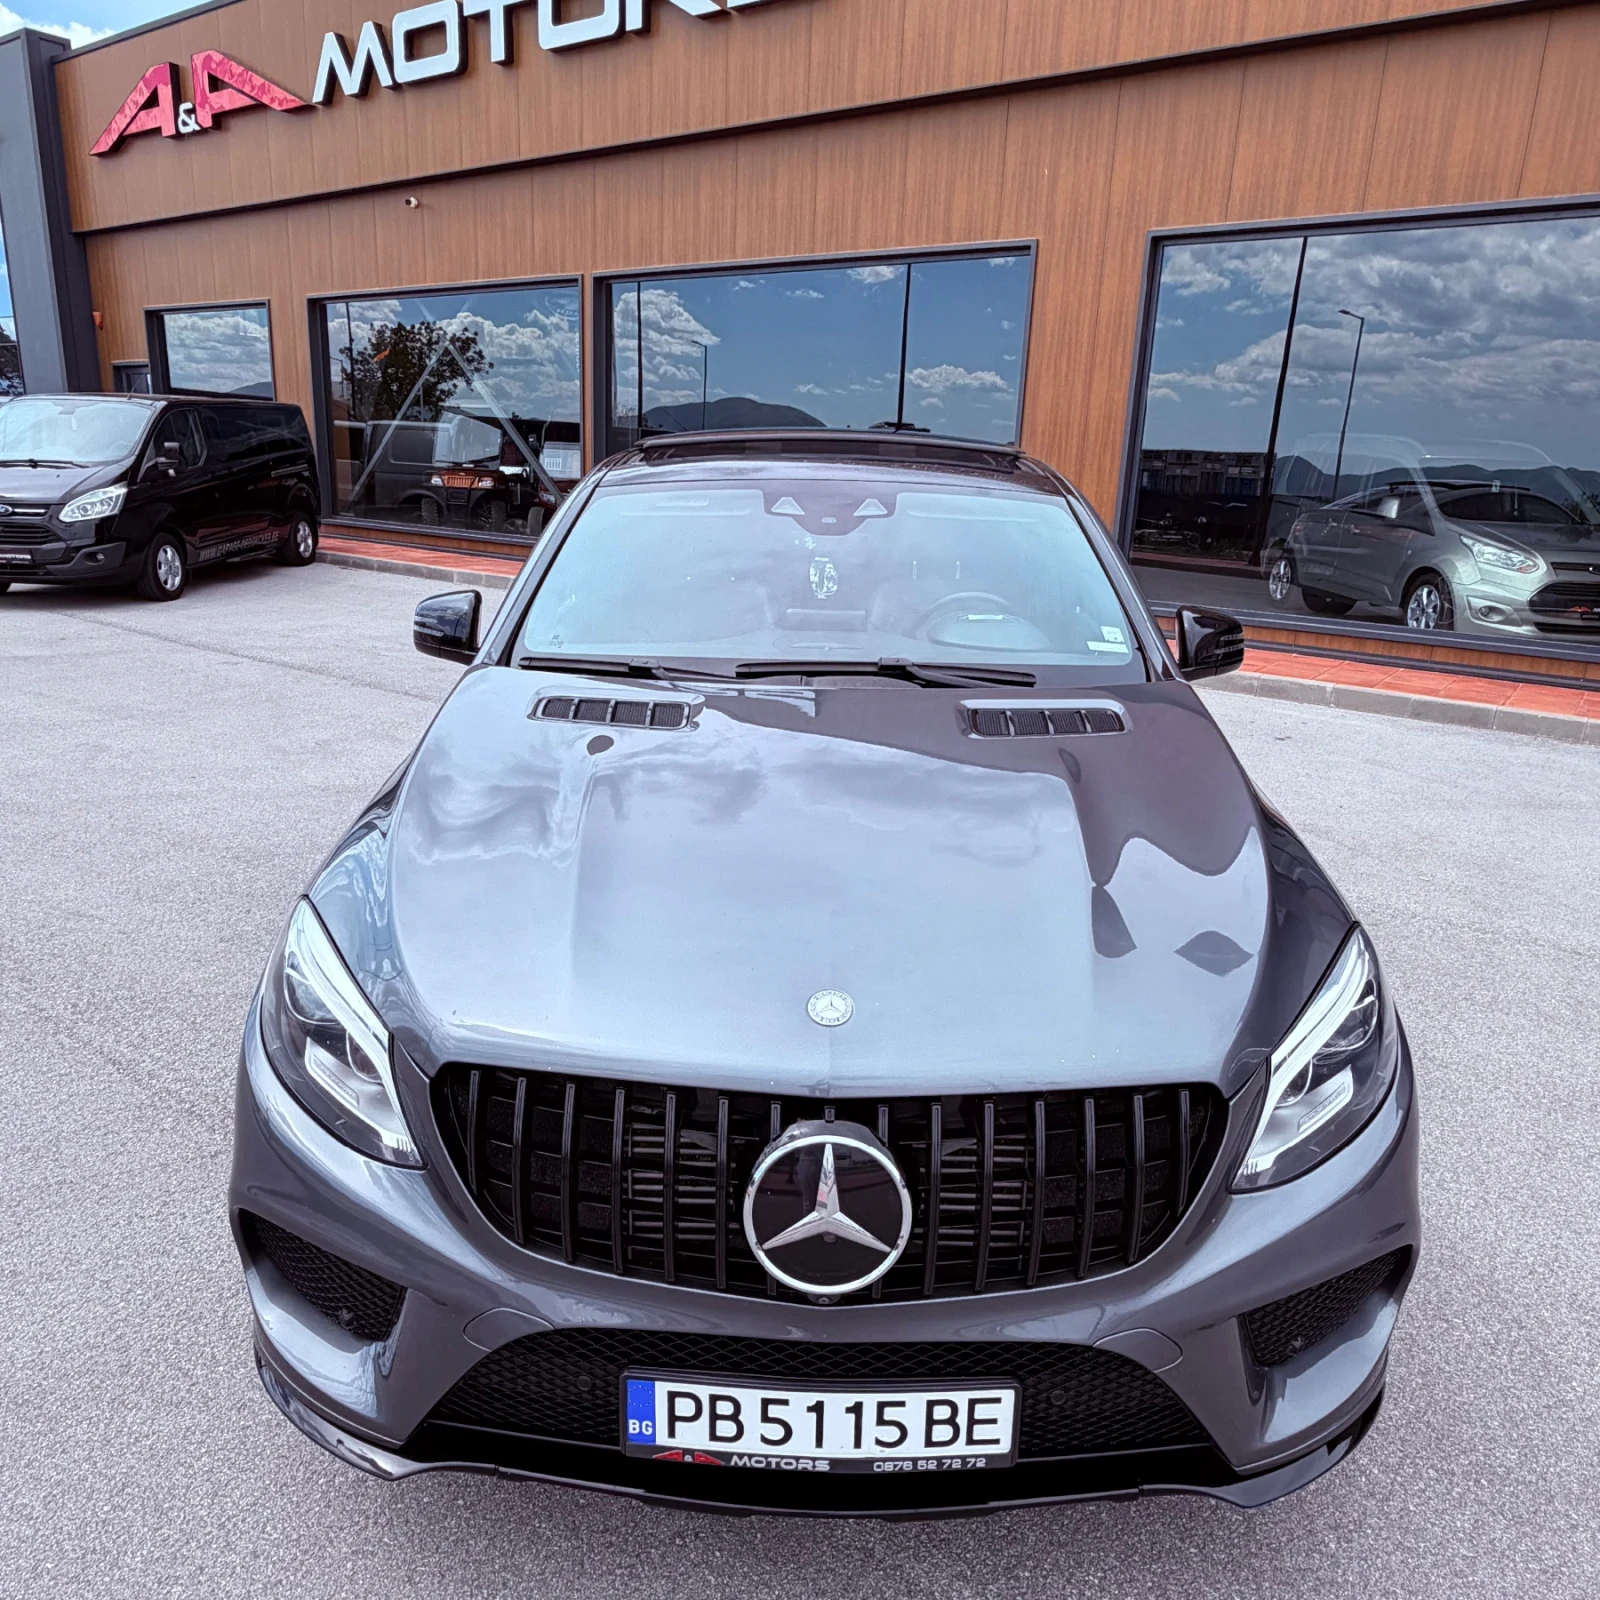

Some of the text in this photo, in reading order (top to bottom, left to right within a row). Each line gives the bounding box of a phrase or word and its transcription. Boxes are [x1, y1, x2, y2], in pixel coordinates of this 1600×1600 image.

[312, 0, 775, 104] MOTO
[628, 1419, 653, 1435] BG
[667, 1390, 1002, 1449] PB 5115 BE
[730, 1455, 831, 1472] MOTORS
[873, 1457, 987, 1472] 0876 52 72 72
